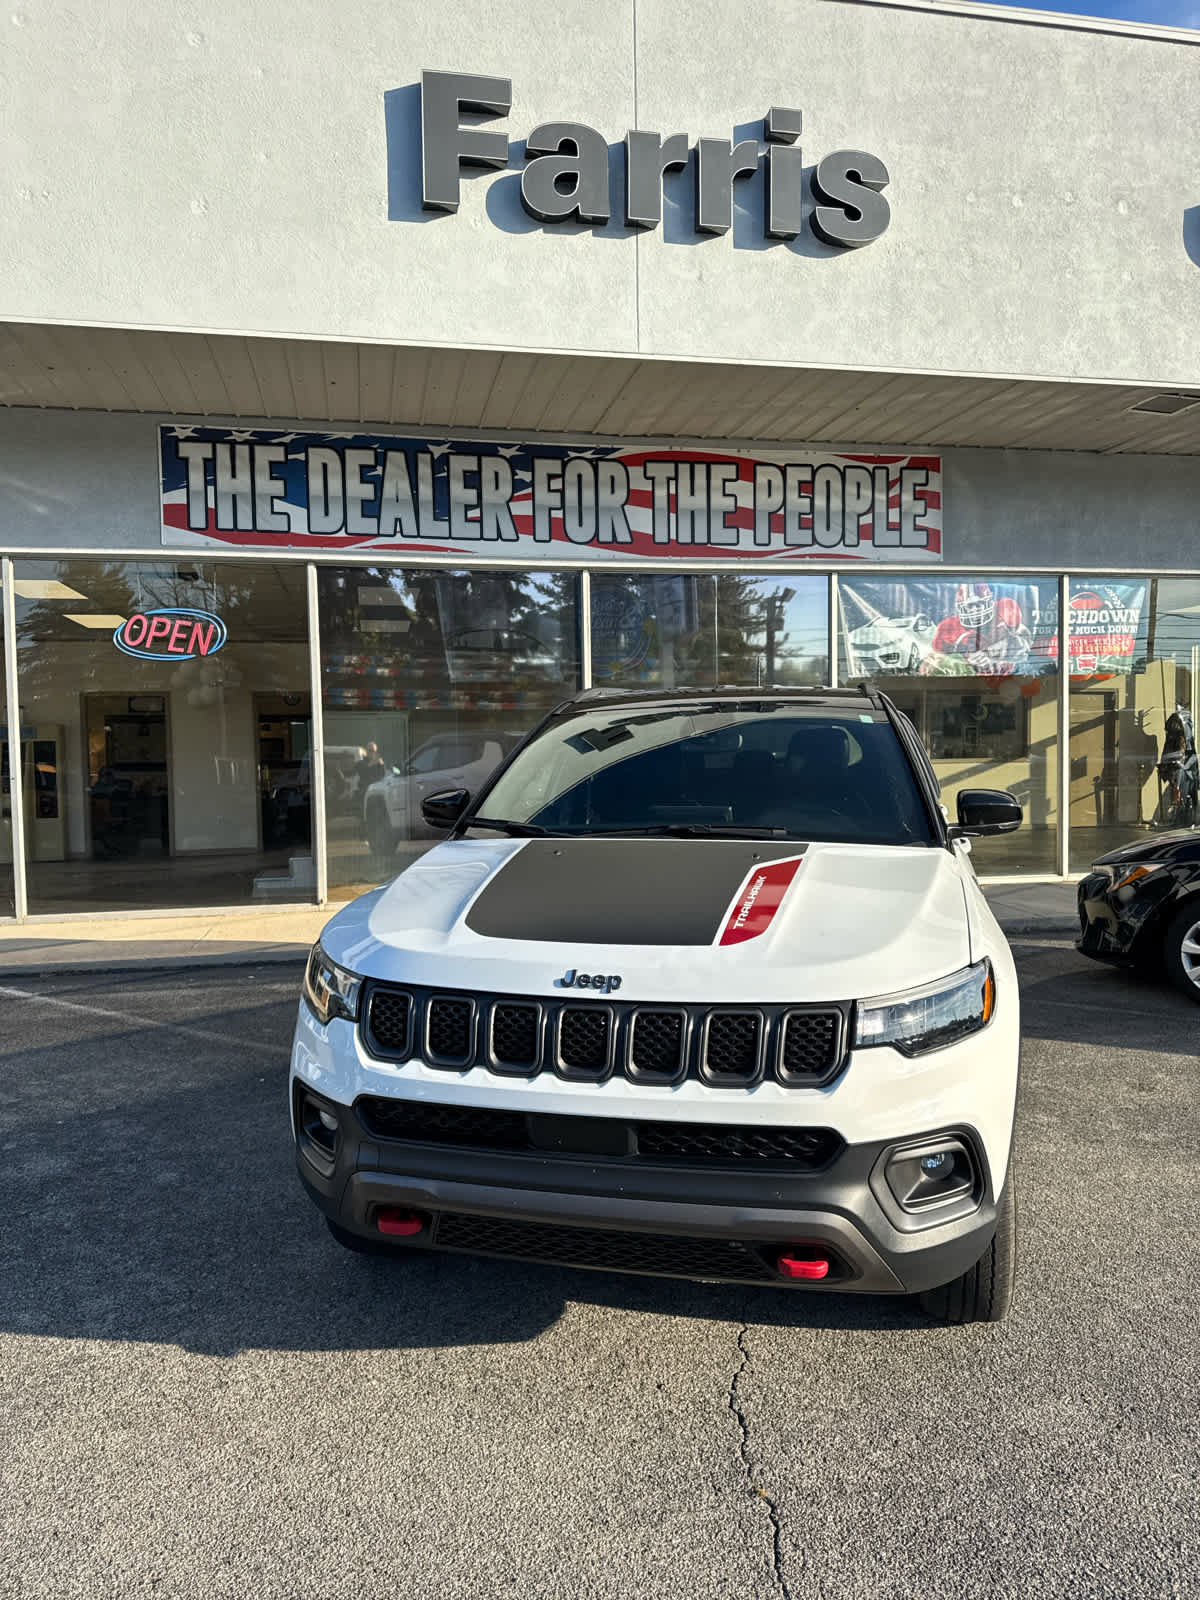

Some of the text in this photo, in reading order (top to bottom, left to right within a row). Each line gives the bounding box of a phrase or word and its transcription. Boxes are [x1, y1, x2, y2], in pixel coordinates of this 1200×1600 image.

[421, 69, 892, 246] Farris
[177, 440, 930, 549] THE DEALER FOR THE PEOPLE
[123, 613, 216, 657] OPEN
[1032, 608, 1141, 625] TOCHDOWN
[1075, 624, 1105, 635] MUCH
[732, 875, 767, 930] TRAILHAWK
[559, 968, 622, 994] Jeep
